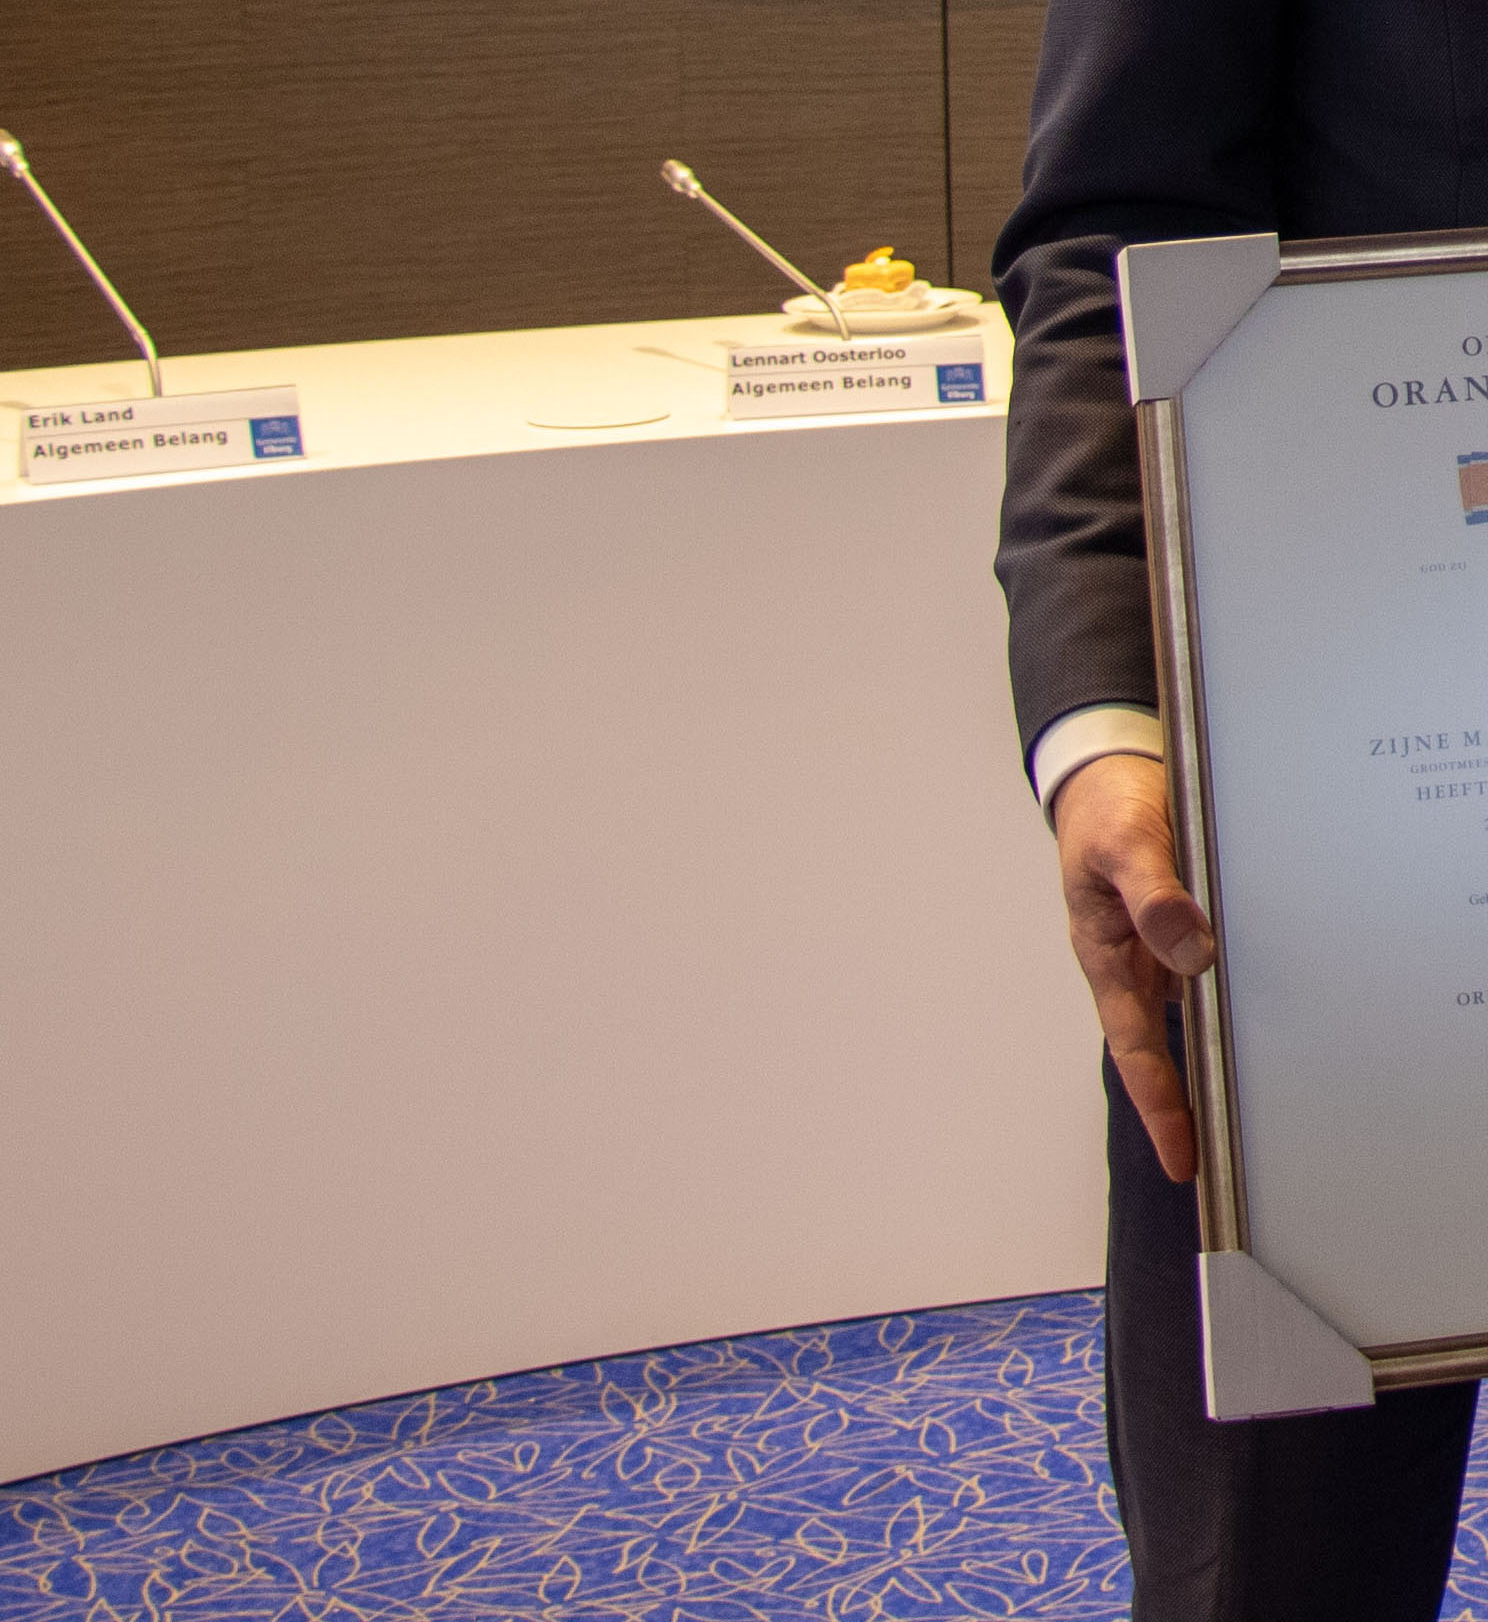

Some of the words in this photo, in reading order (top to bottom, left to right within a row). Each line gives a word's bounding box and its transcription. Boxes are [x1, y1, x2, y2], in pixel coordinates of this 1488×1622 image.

[732, 352, 805, 368] Lennart
[813, 348, 906, 363] Oosterloo
[732, 379, 834, 397] Algemeen
[843, 374, 912, 389] Belang
[28, 411, 72, 429] Erik
[81, 407, 134, 424] Land
[34, 436, 144, 459] Algemeen
[153, 429, 228, 448] Belang
[1369, 733, 1449, 758] ZIJNE
[1416, 780, 1488, 801] HEEFT
